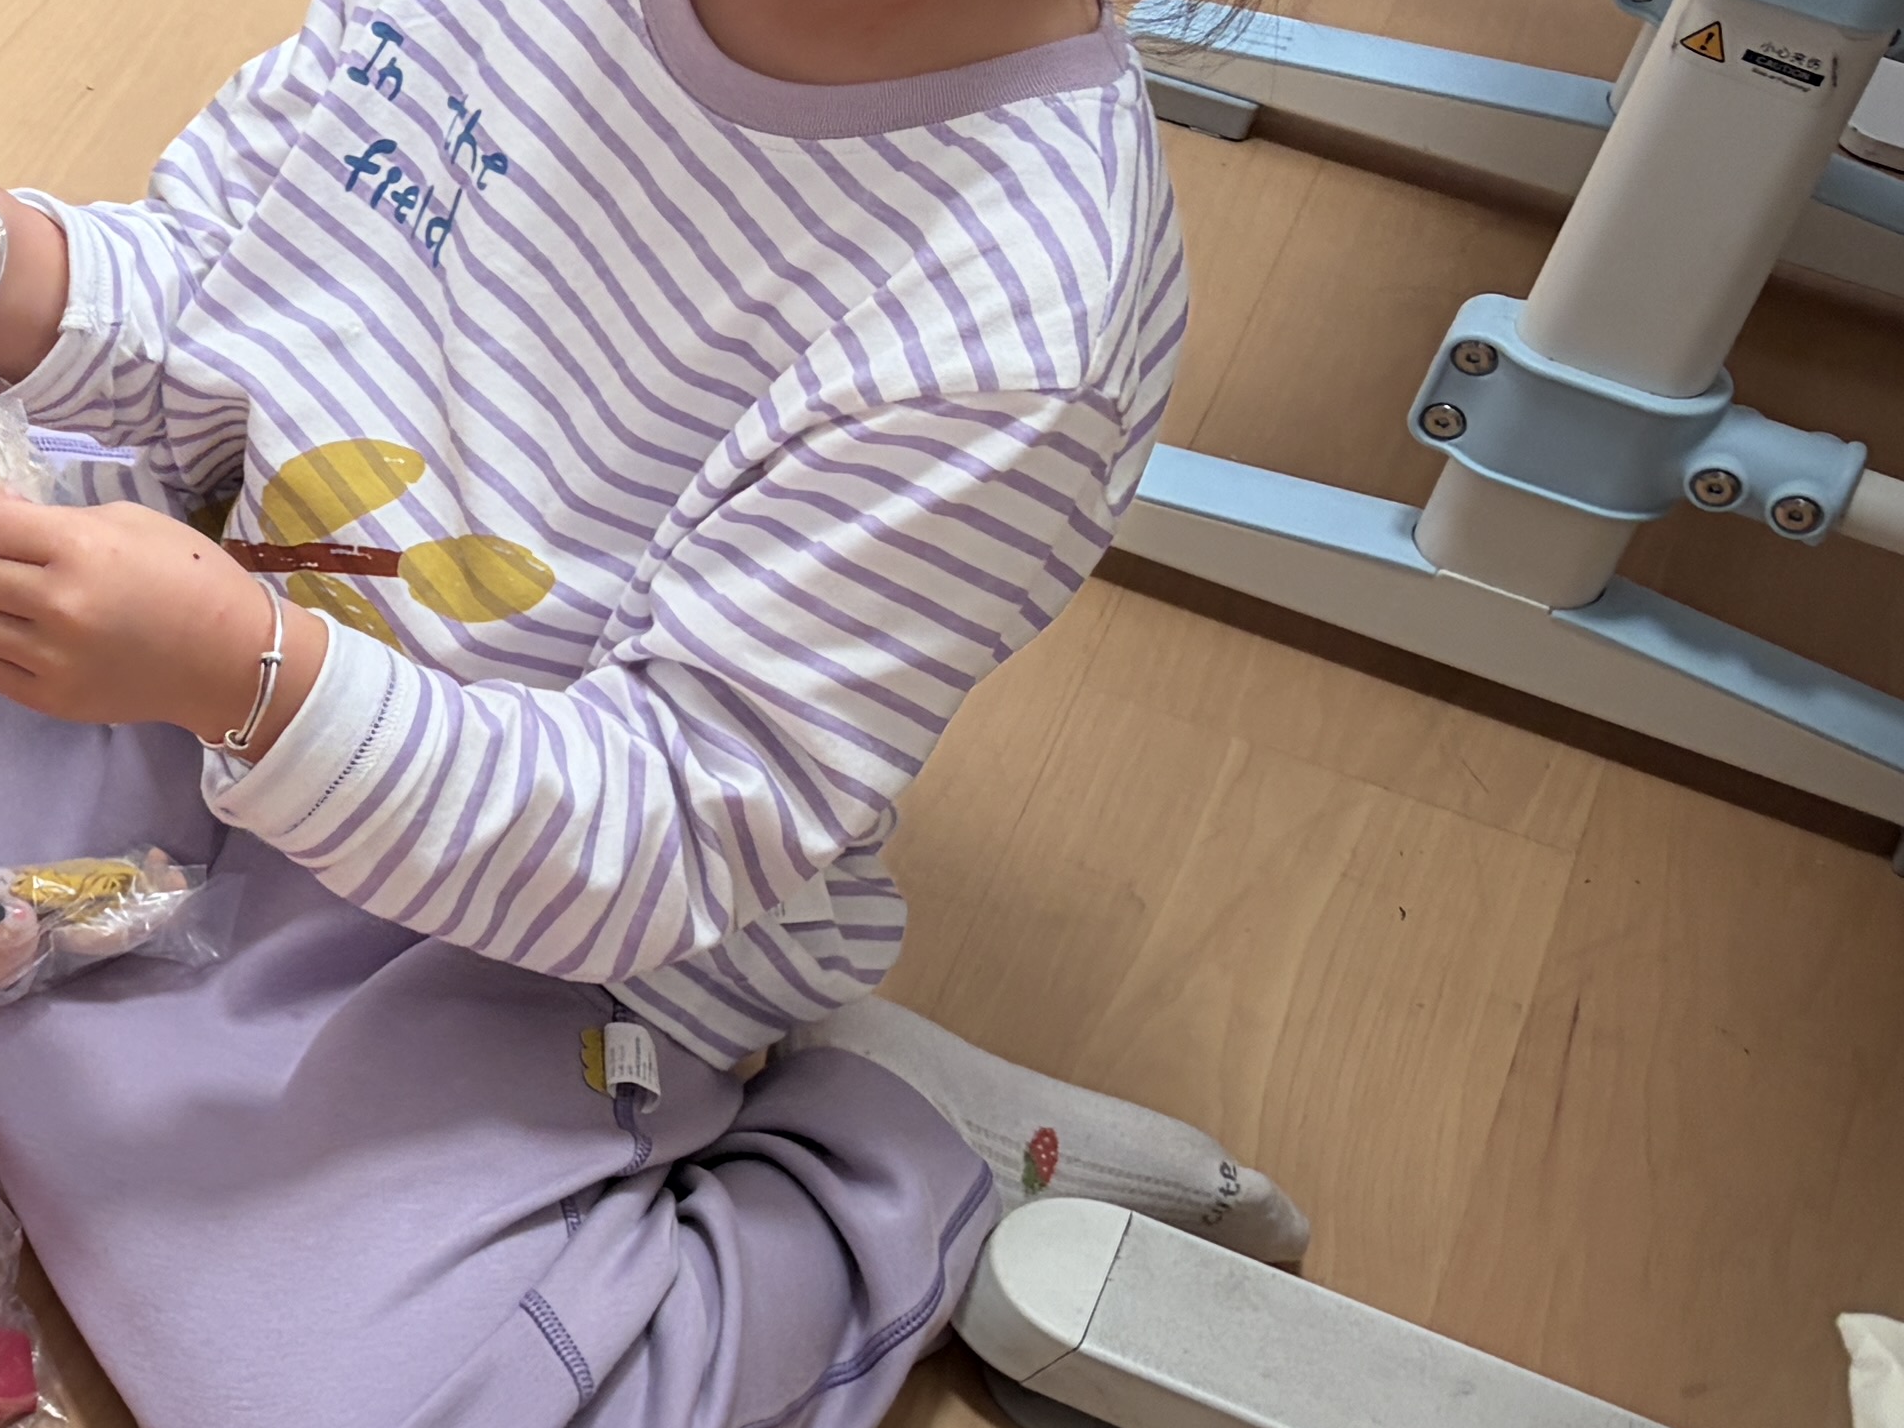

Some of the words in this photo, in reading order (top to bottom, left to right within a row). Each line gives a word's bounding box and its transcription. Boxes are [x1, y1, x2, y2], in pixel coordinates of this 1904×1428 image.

[346, 20, 405, 102] In
[443, 94, 509, 191] the
[343, 137, 463, 268] field
